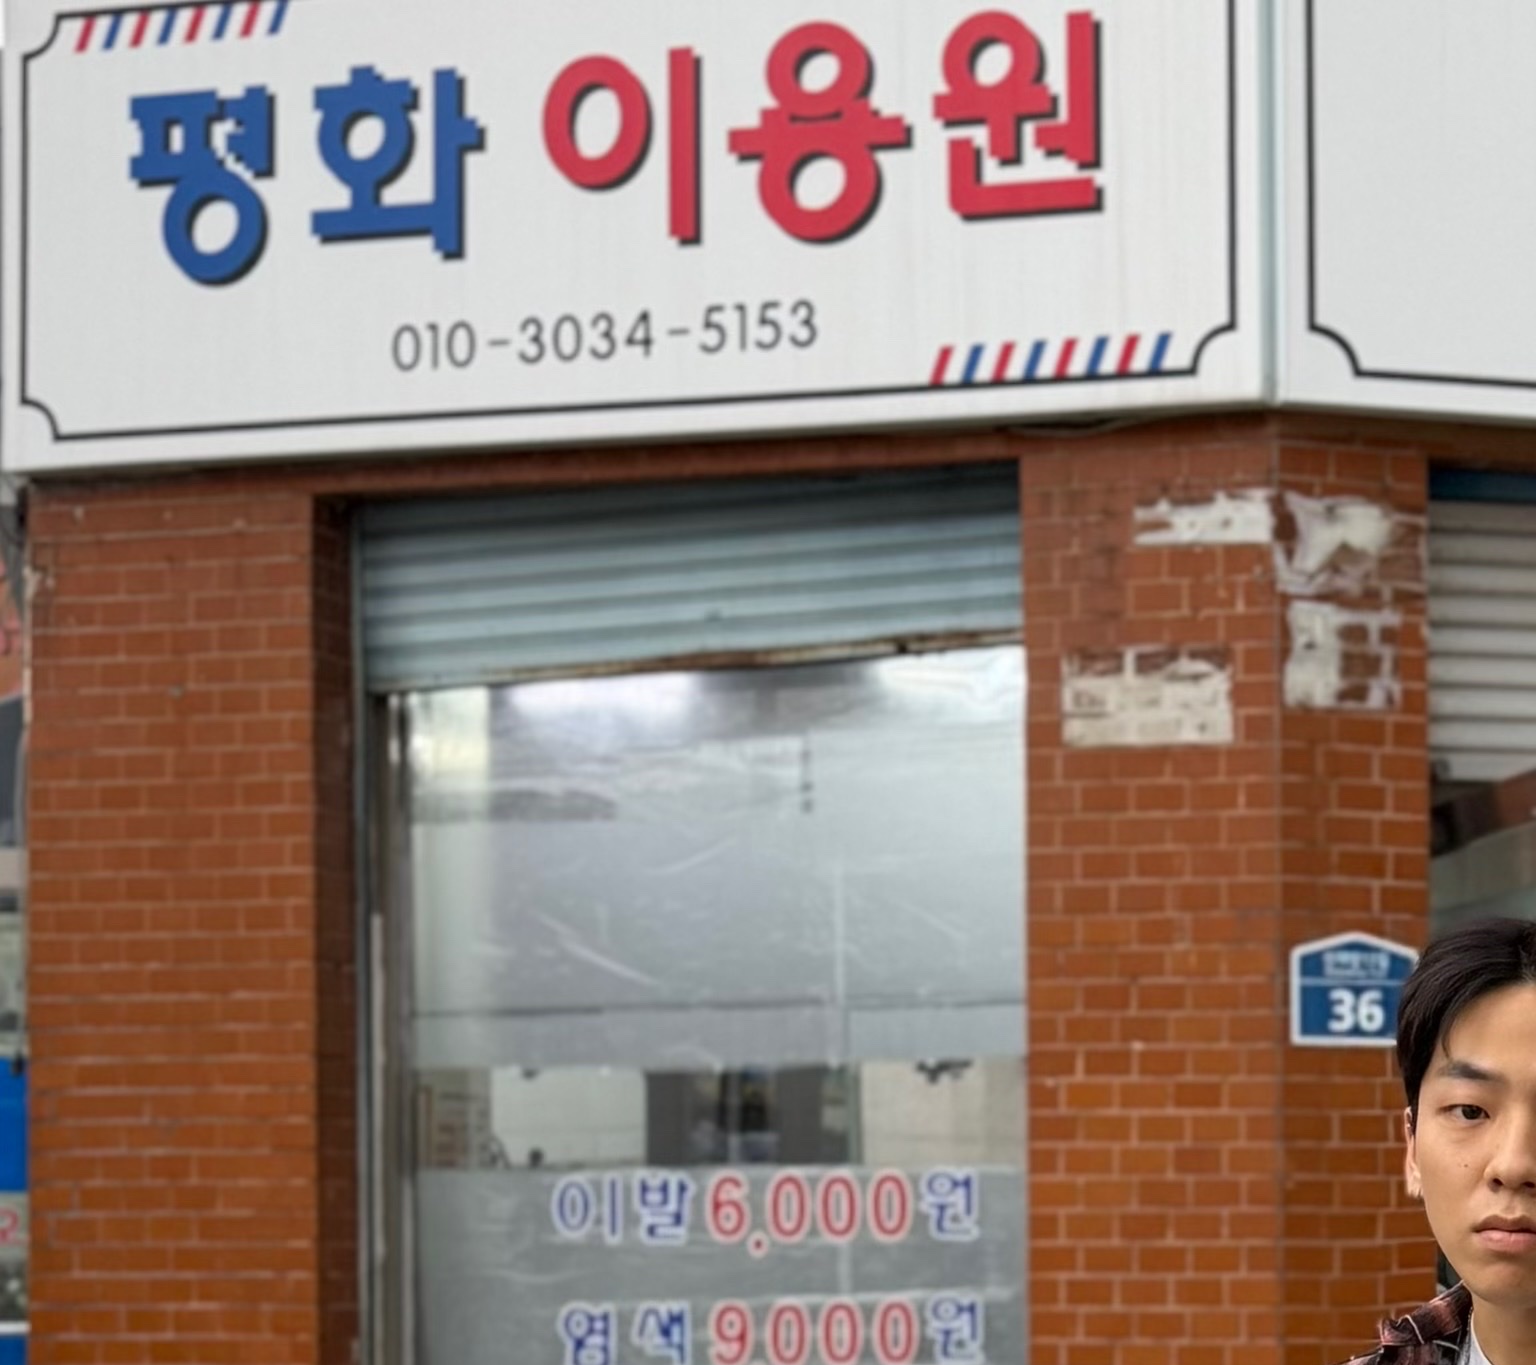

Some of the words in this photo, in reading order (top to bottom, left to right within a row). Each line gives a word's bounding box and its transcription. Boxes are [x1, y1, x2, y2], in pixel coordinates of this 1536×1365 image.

[129, 66, 486, 288] 평화
[543, 11, 1104, 250] 이용원
[391, 299, 818, 372] 010-3034-5153
[1328, 988, 1385, 1033] 36
[553, 1170, 692, 1244] 이발
